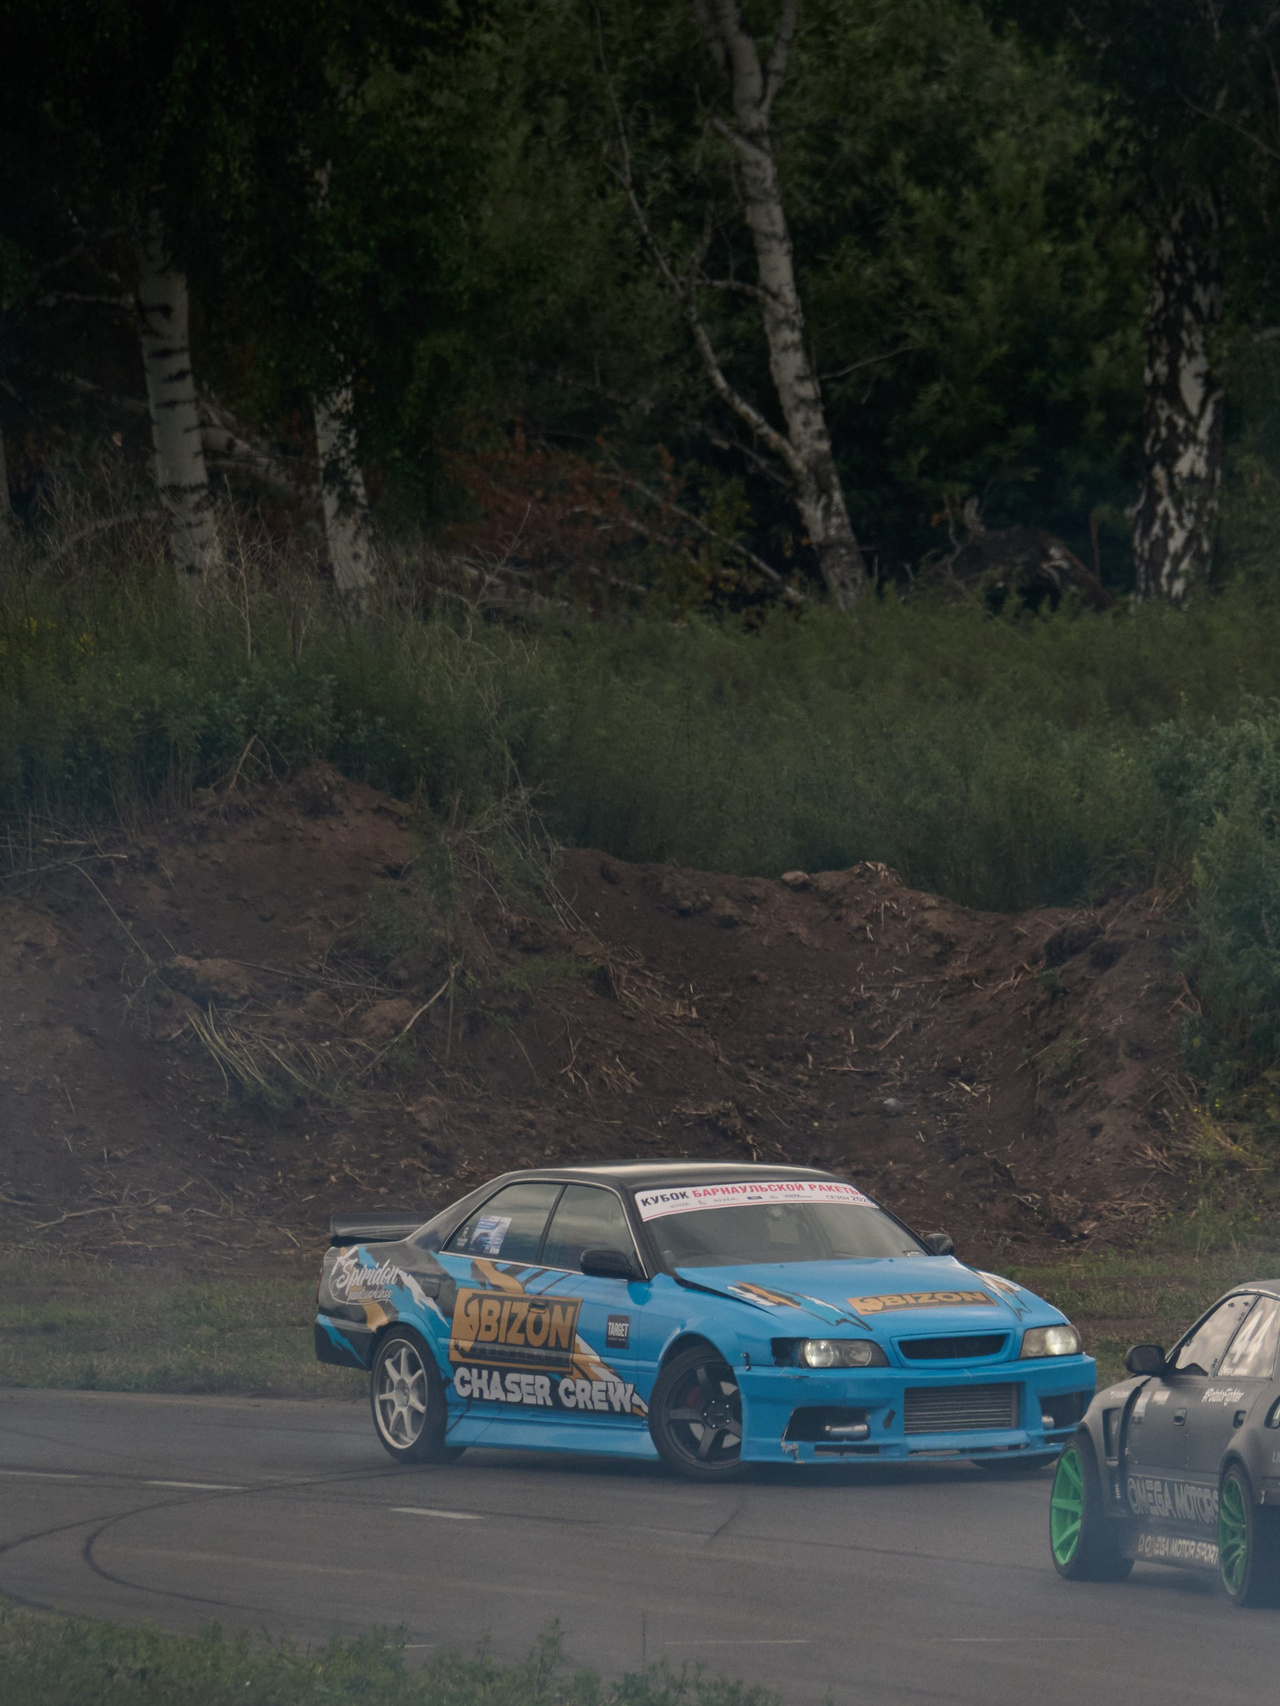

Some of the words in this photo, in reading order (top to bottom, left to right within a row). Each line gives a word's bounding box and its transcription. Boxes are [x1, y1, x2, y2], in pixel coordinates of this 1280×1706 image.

[640, 1191, 690, 1207] КУБОК
[691, 1182, 805, 1198] БАРНАУЛЬСКОЙ
[850, 1195, 872, 1203] 202
[336, 1258, 400, 1297] Spiridon
[878, 1291, 988, 1306] BIZON
[477, 1298, 576, 1349] BIZON
[608, 1322, 629, 1337] TARGET
[1229, 1310, 1277, 1365] 44
[453, 1366, 553, 1406] CHASER
[558, 1378, 634, 1412] CREW
